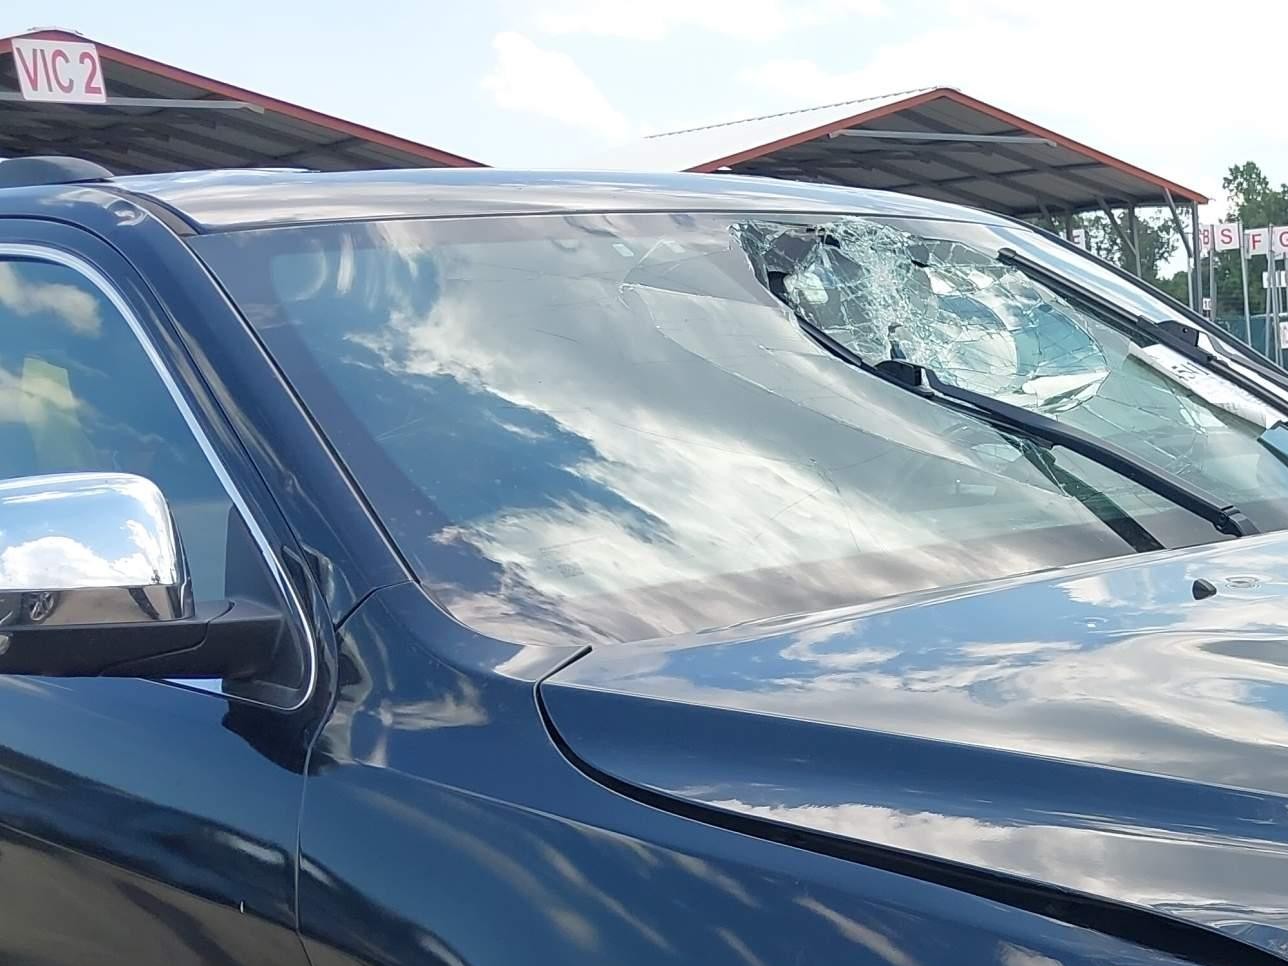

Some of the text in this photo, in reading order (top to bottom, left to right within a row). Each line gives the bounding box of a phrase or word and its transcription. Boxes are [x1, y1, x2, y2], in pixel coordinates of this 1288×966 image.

[16, 47, 102, 94] VIC 2
[1220, 228, 1233, 244] S
[1252, 233, 1262, 250] F
